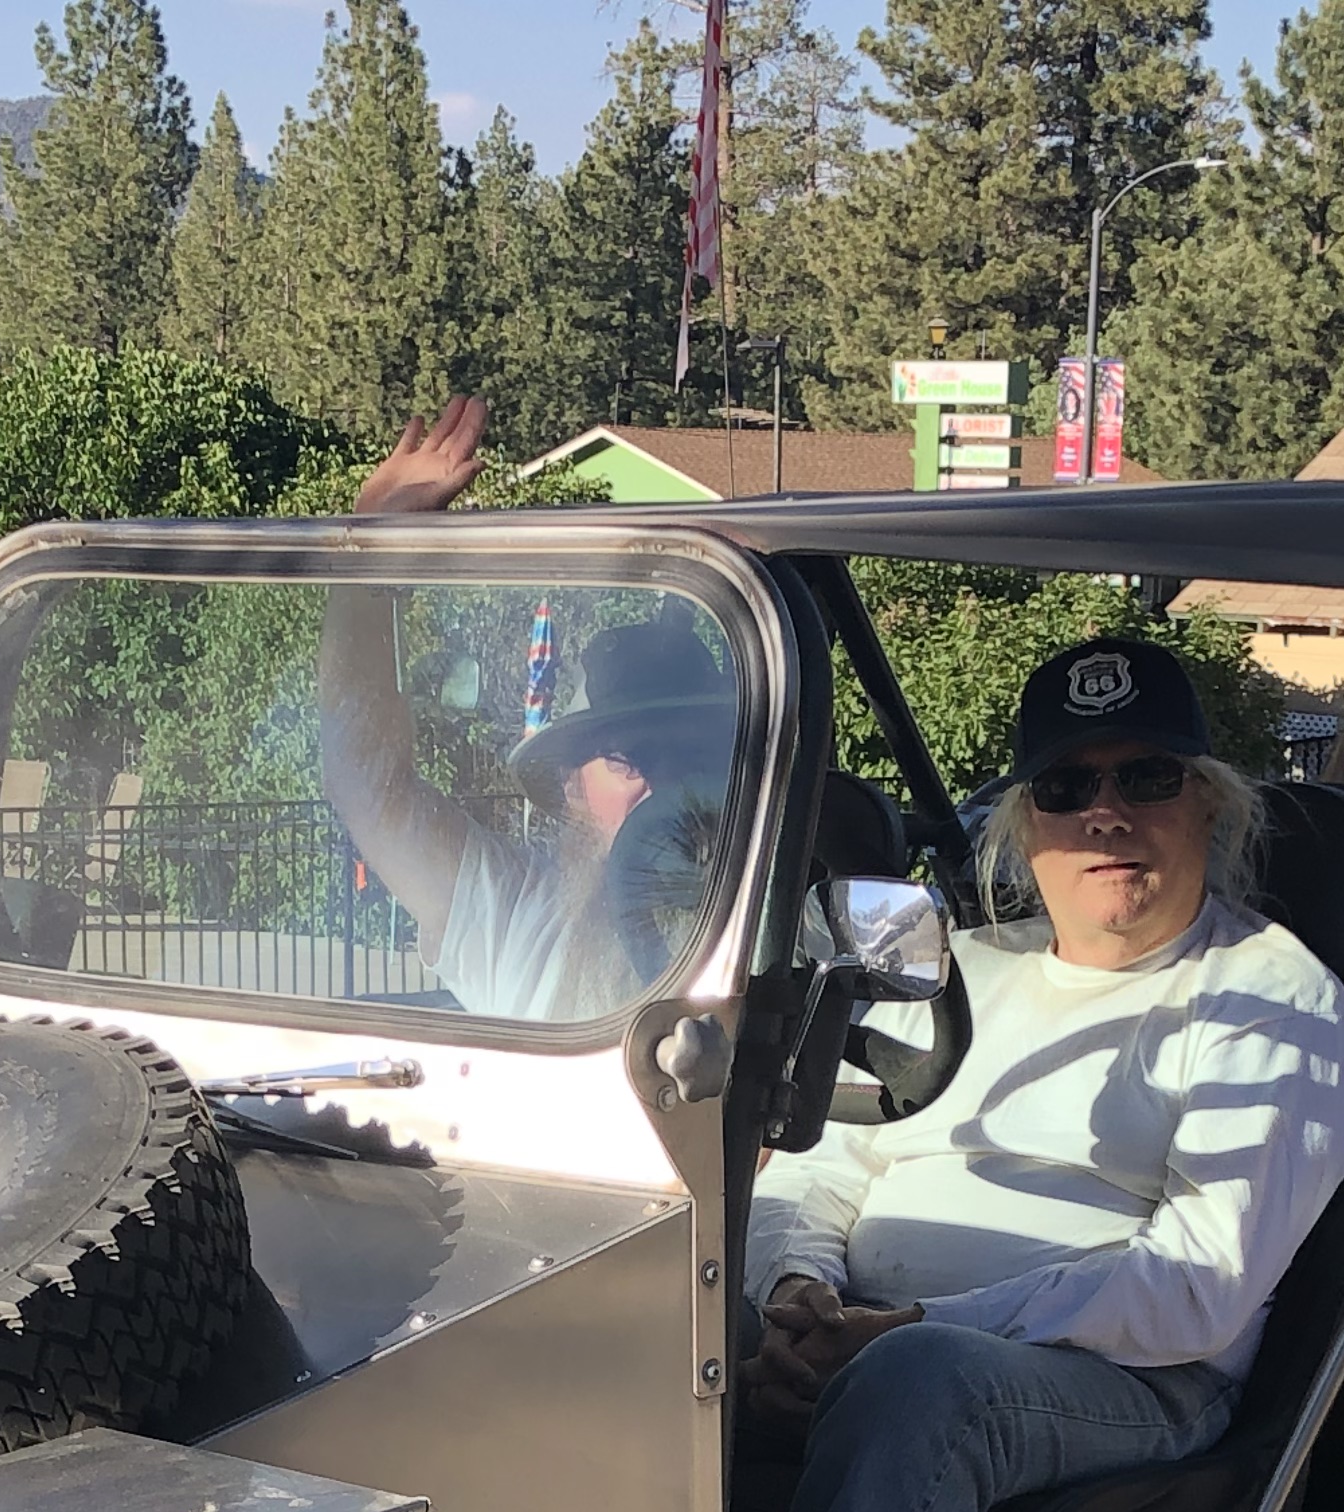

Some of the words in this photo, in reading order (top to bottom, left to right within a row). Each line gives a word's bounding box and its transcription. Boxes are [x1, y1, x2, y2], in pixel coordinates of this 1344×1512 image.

[918, 378, 957, 396] Green
[961, 379, 1003, 396] House
[1085, 675, 1116, 695] 66
